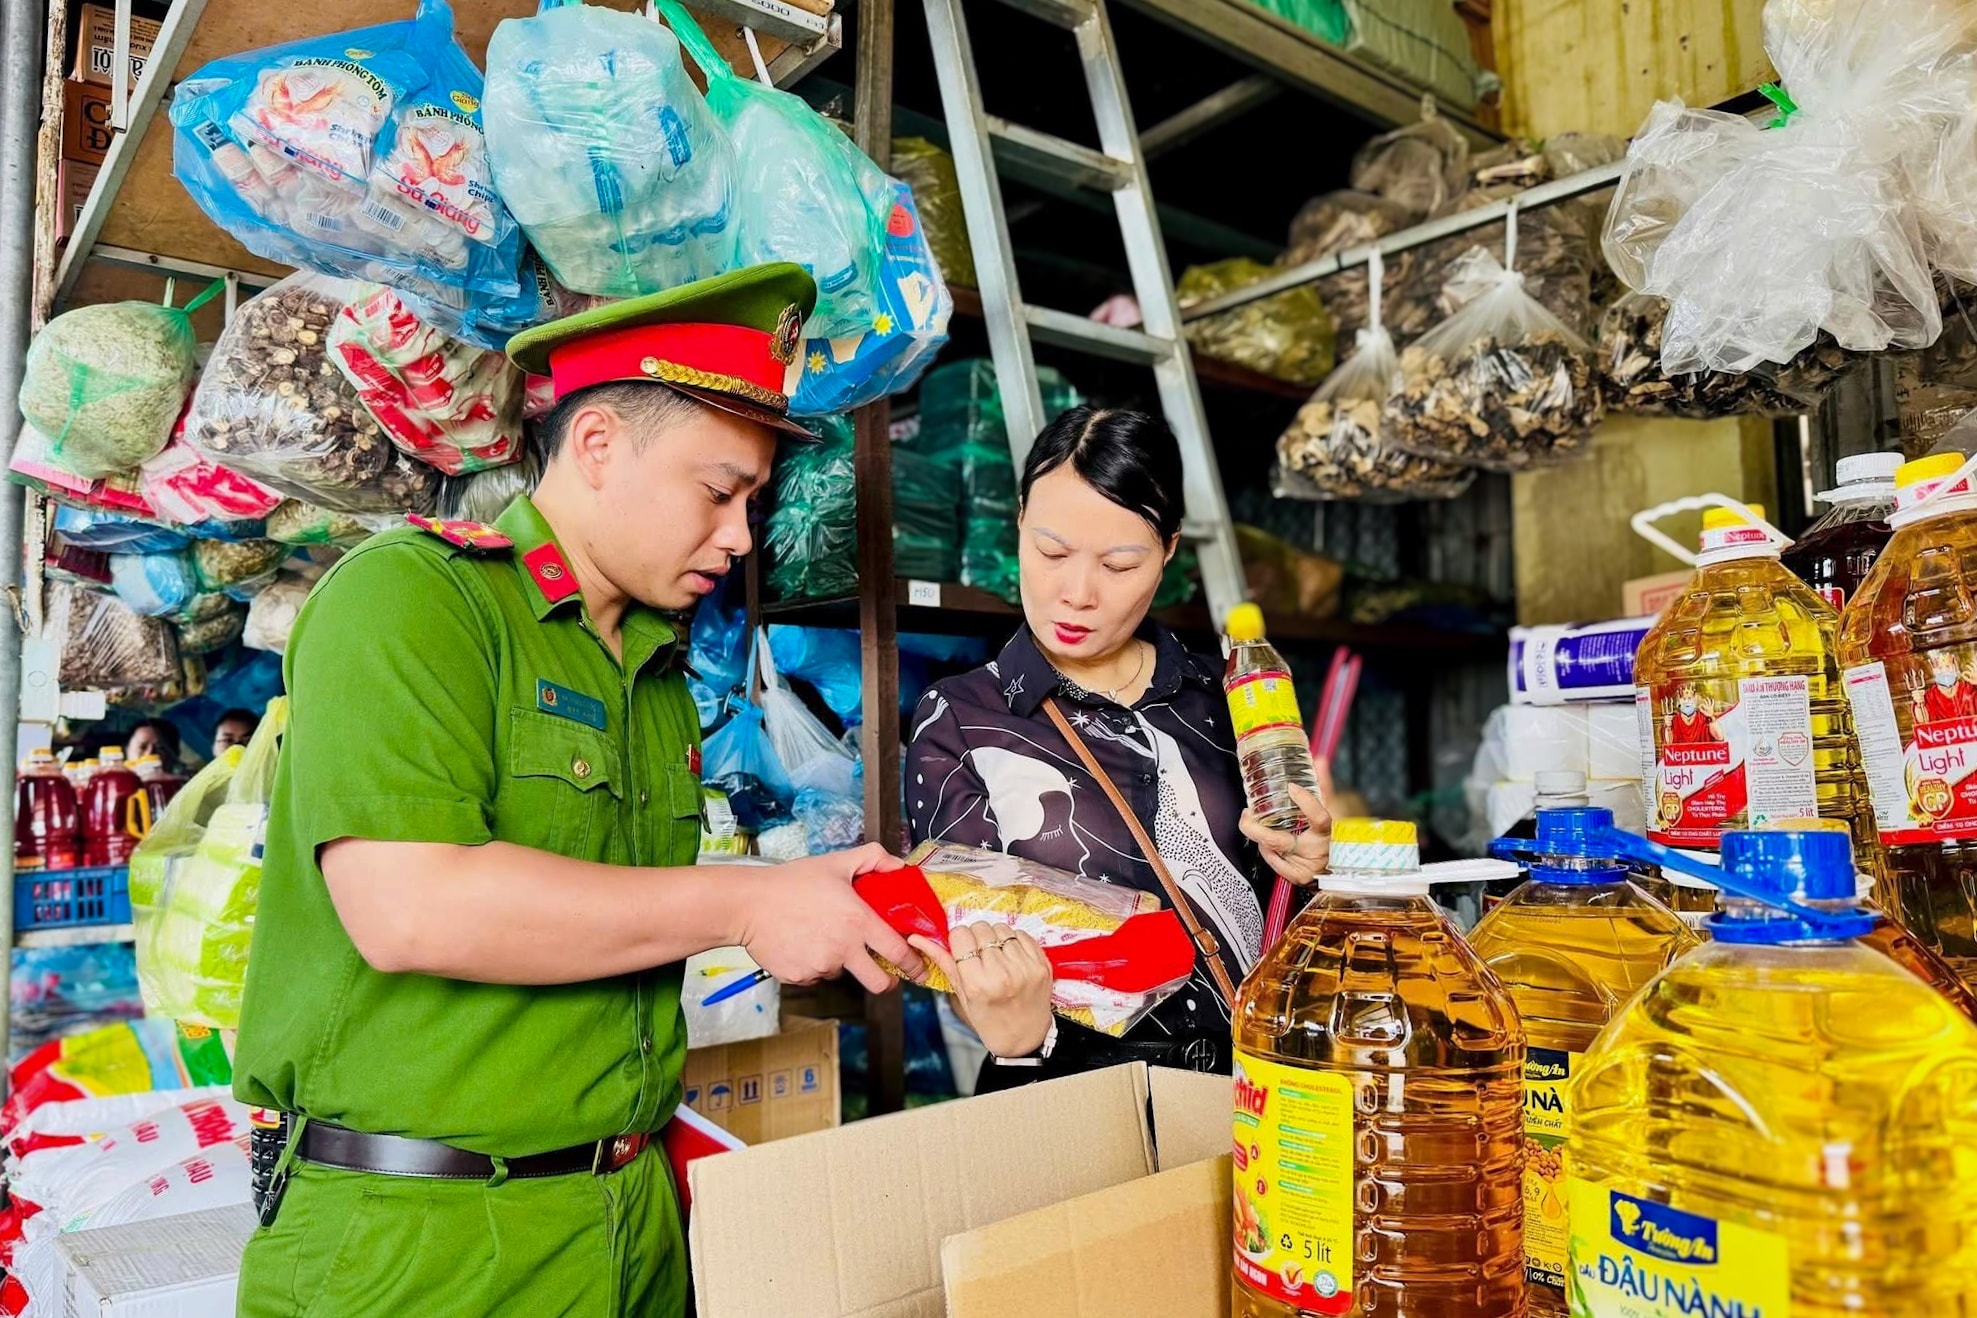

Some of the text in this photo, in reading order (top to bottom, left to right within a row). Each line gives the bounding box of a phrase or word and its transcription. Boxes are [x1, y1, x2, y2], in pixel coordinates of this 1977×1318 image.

[1916, 724, 1977, 745] Neptu
[1665, 748, 1727, 765] Neptune
[1918, 747, 1965, 775] Light
[1664, 768, 1694, 790] Light
[1304, 1239, 1332, 1264] 5 lít
[1598, 1254, 1658, 1302] ĐẬU
